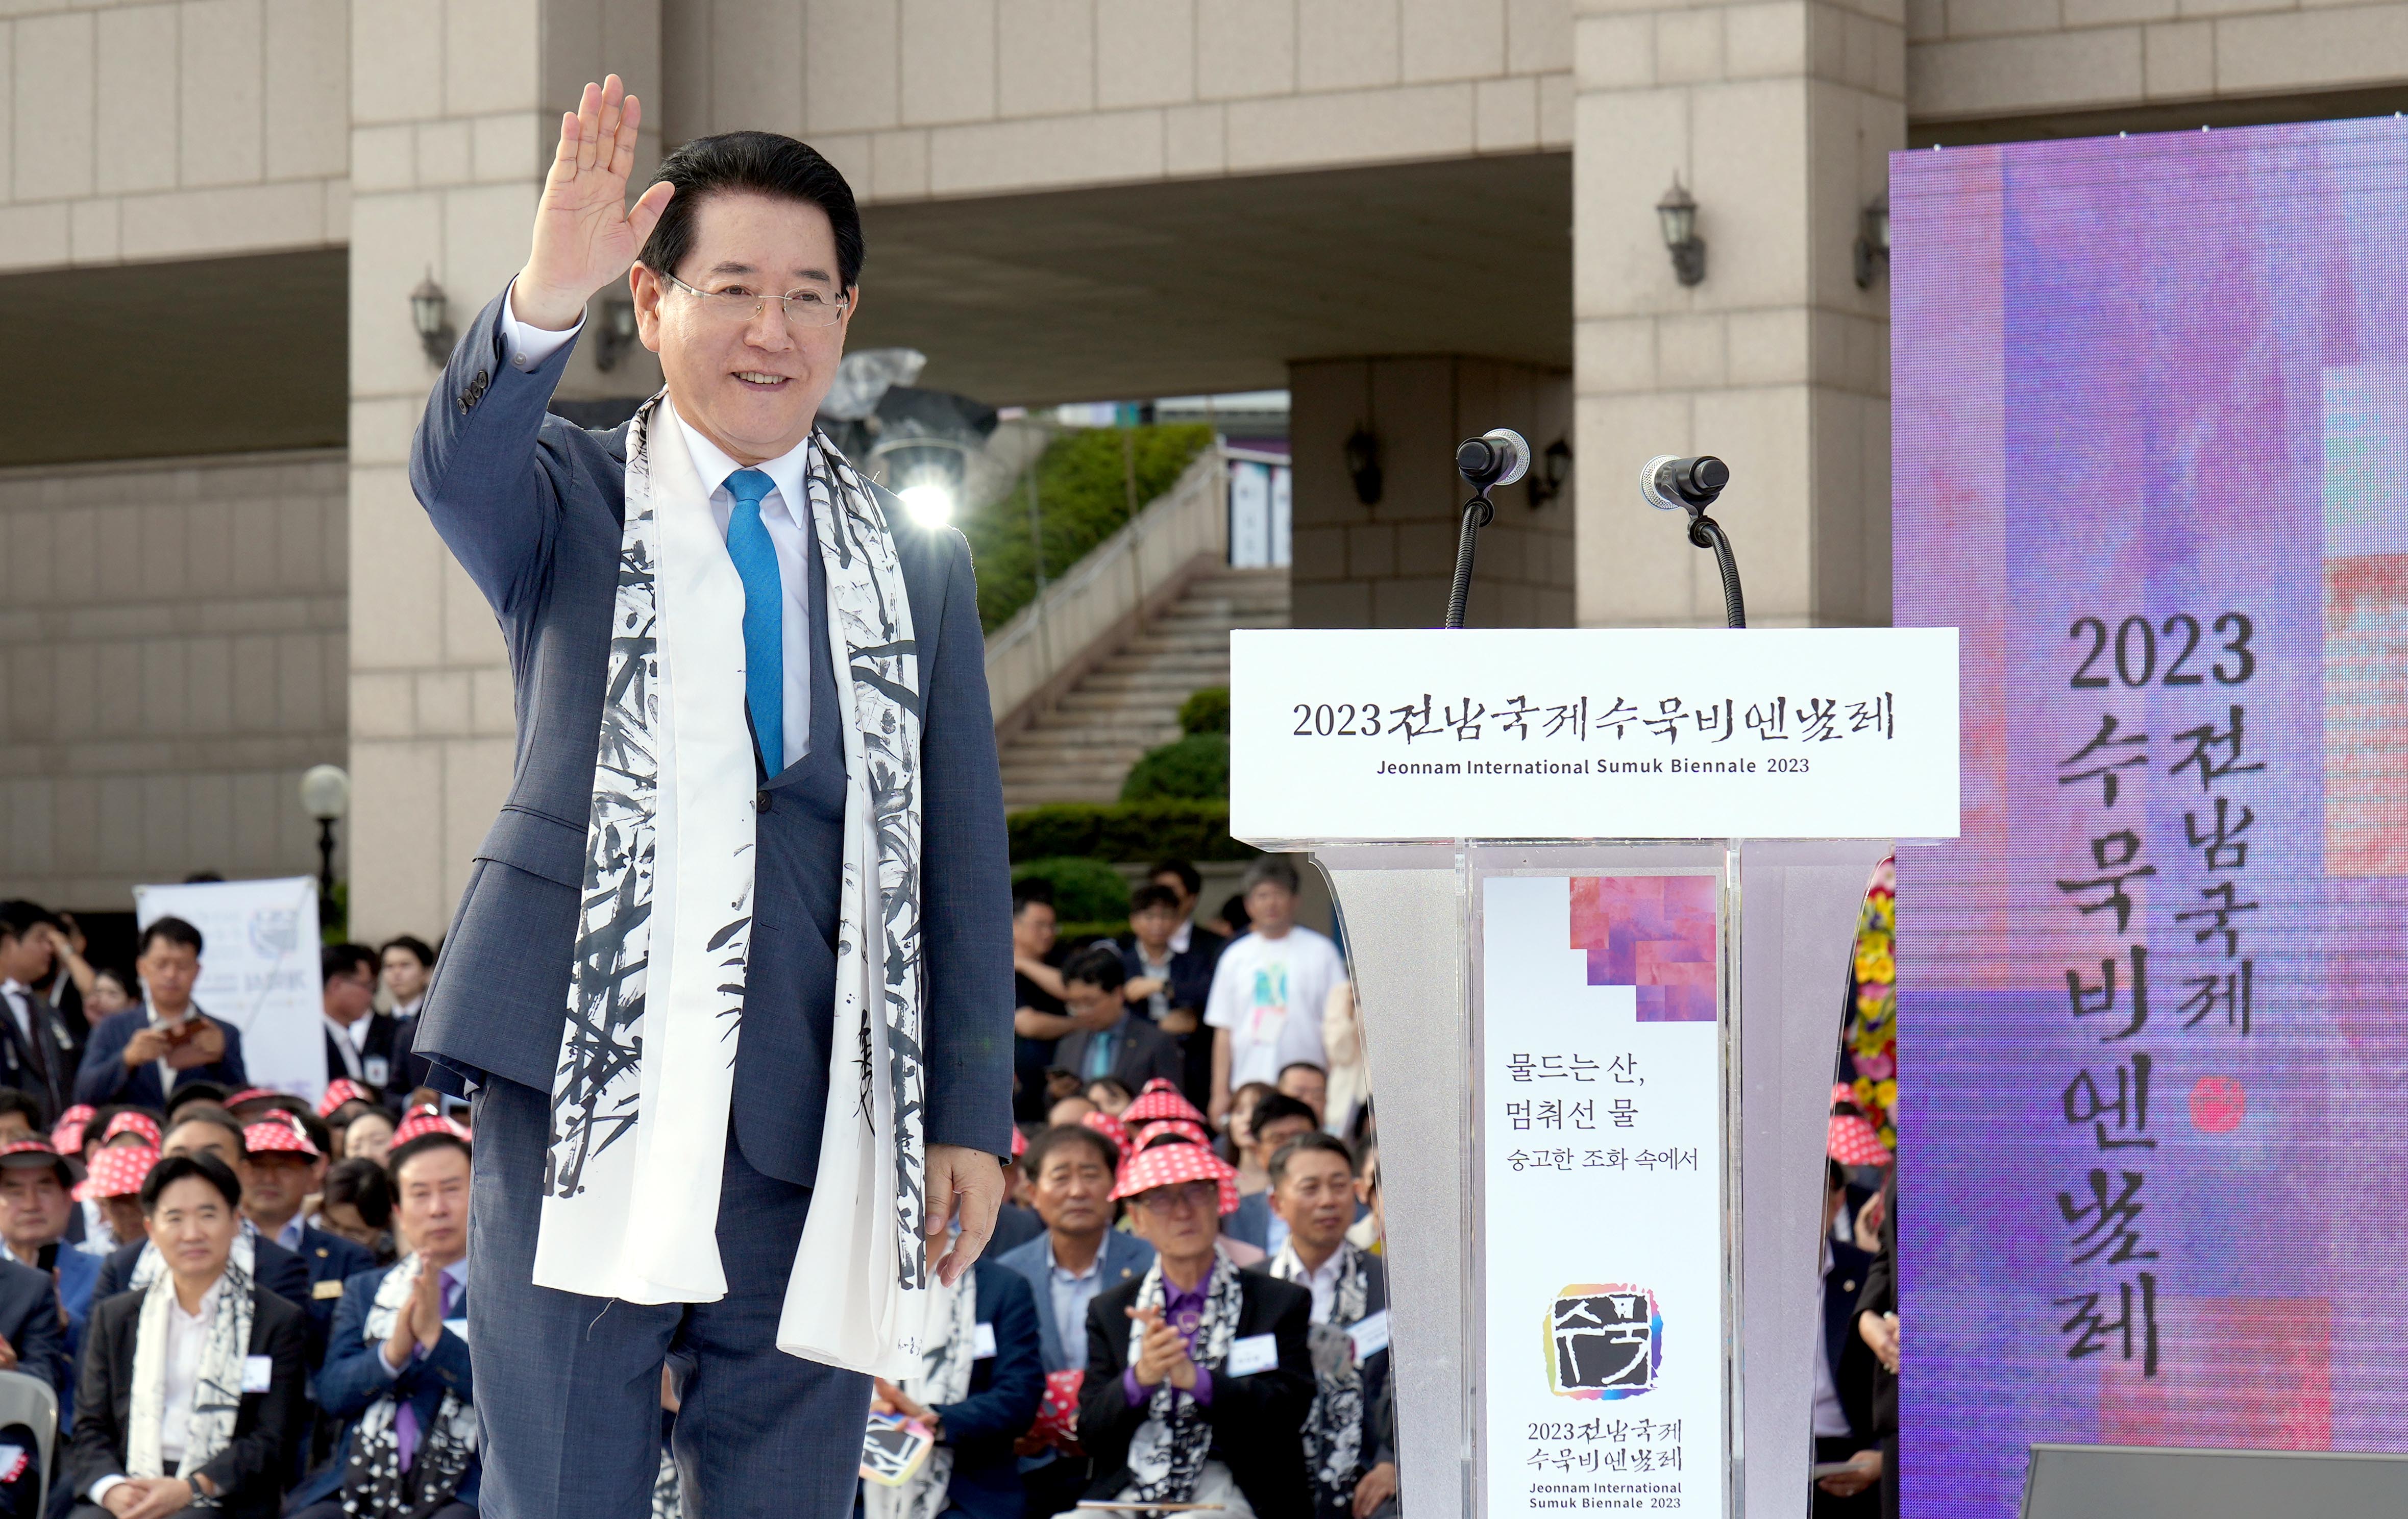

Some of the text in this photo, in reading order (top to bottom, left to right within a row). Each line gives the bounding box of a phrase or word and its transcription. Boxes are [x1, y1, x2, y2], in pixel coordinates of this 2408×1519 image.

[2069, 613, 2255, 689] 2023
[1377, 758, 1810, 774] Jeonnam International Sumuk Biennale 2023
[1506, 1052, 1644, 1087] 물드는 산,
[1506, 1098, 1639, 1131] 멈춰선 물
[1507, 1147, 1698, 1172] 숭고한 조화 속에서
[1530, 1482, 1682, 1493] Jeonnam International
[1530, 1497, 1681, 1509] Sumuk Biennale 2023
